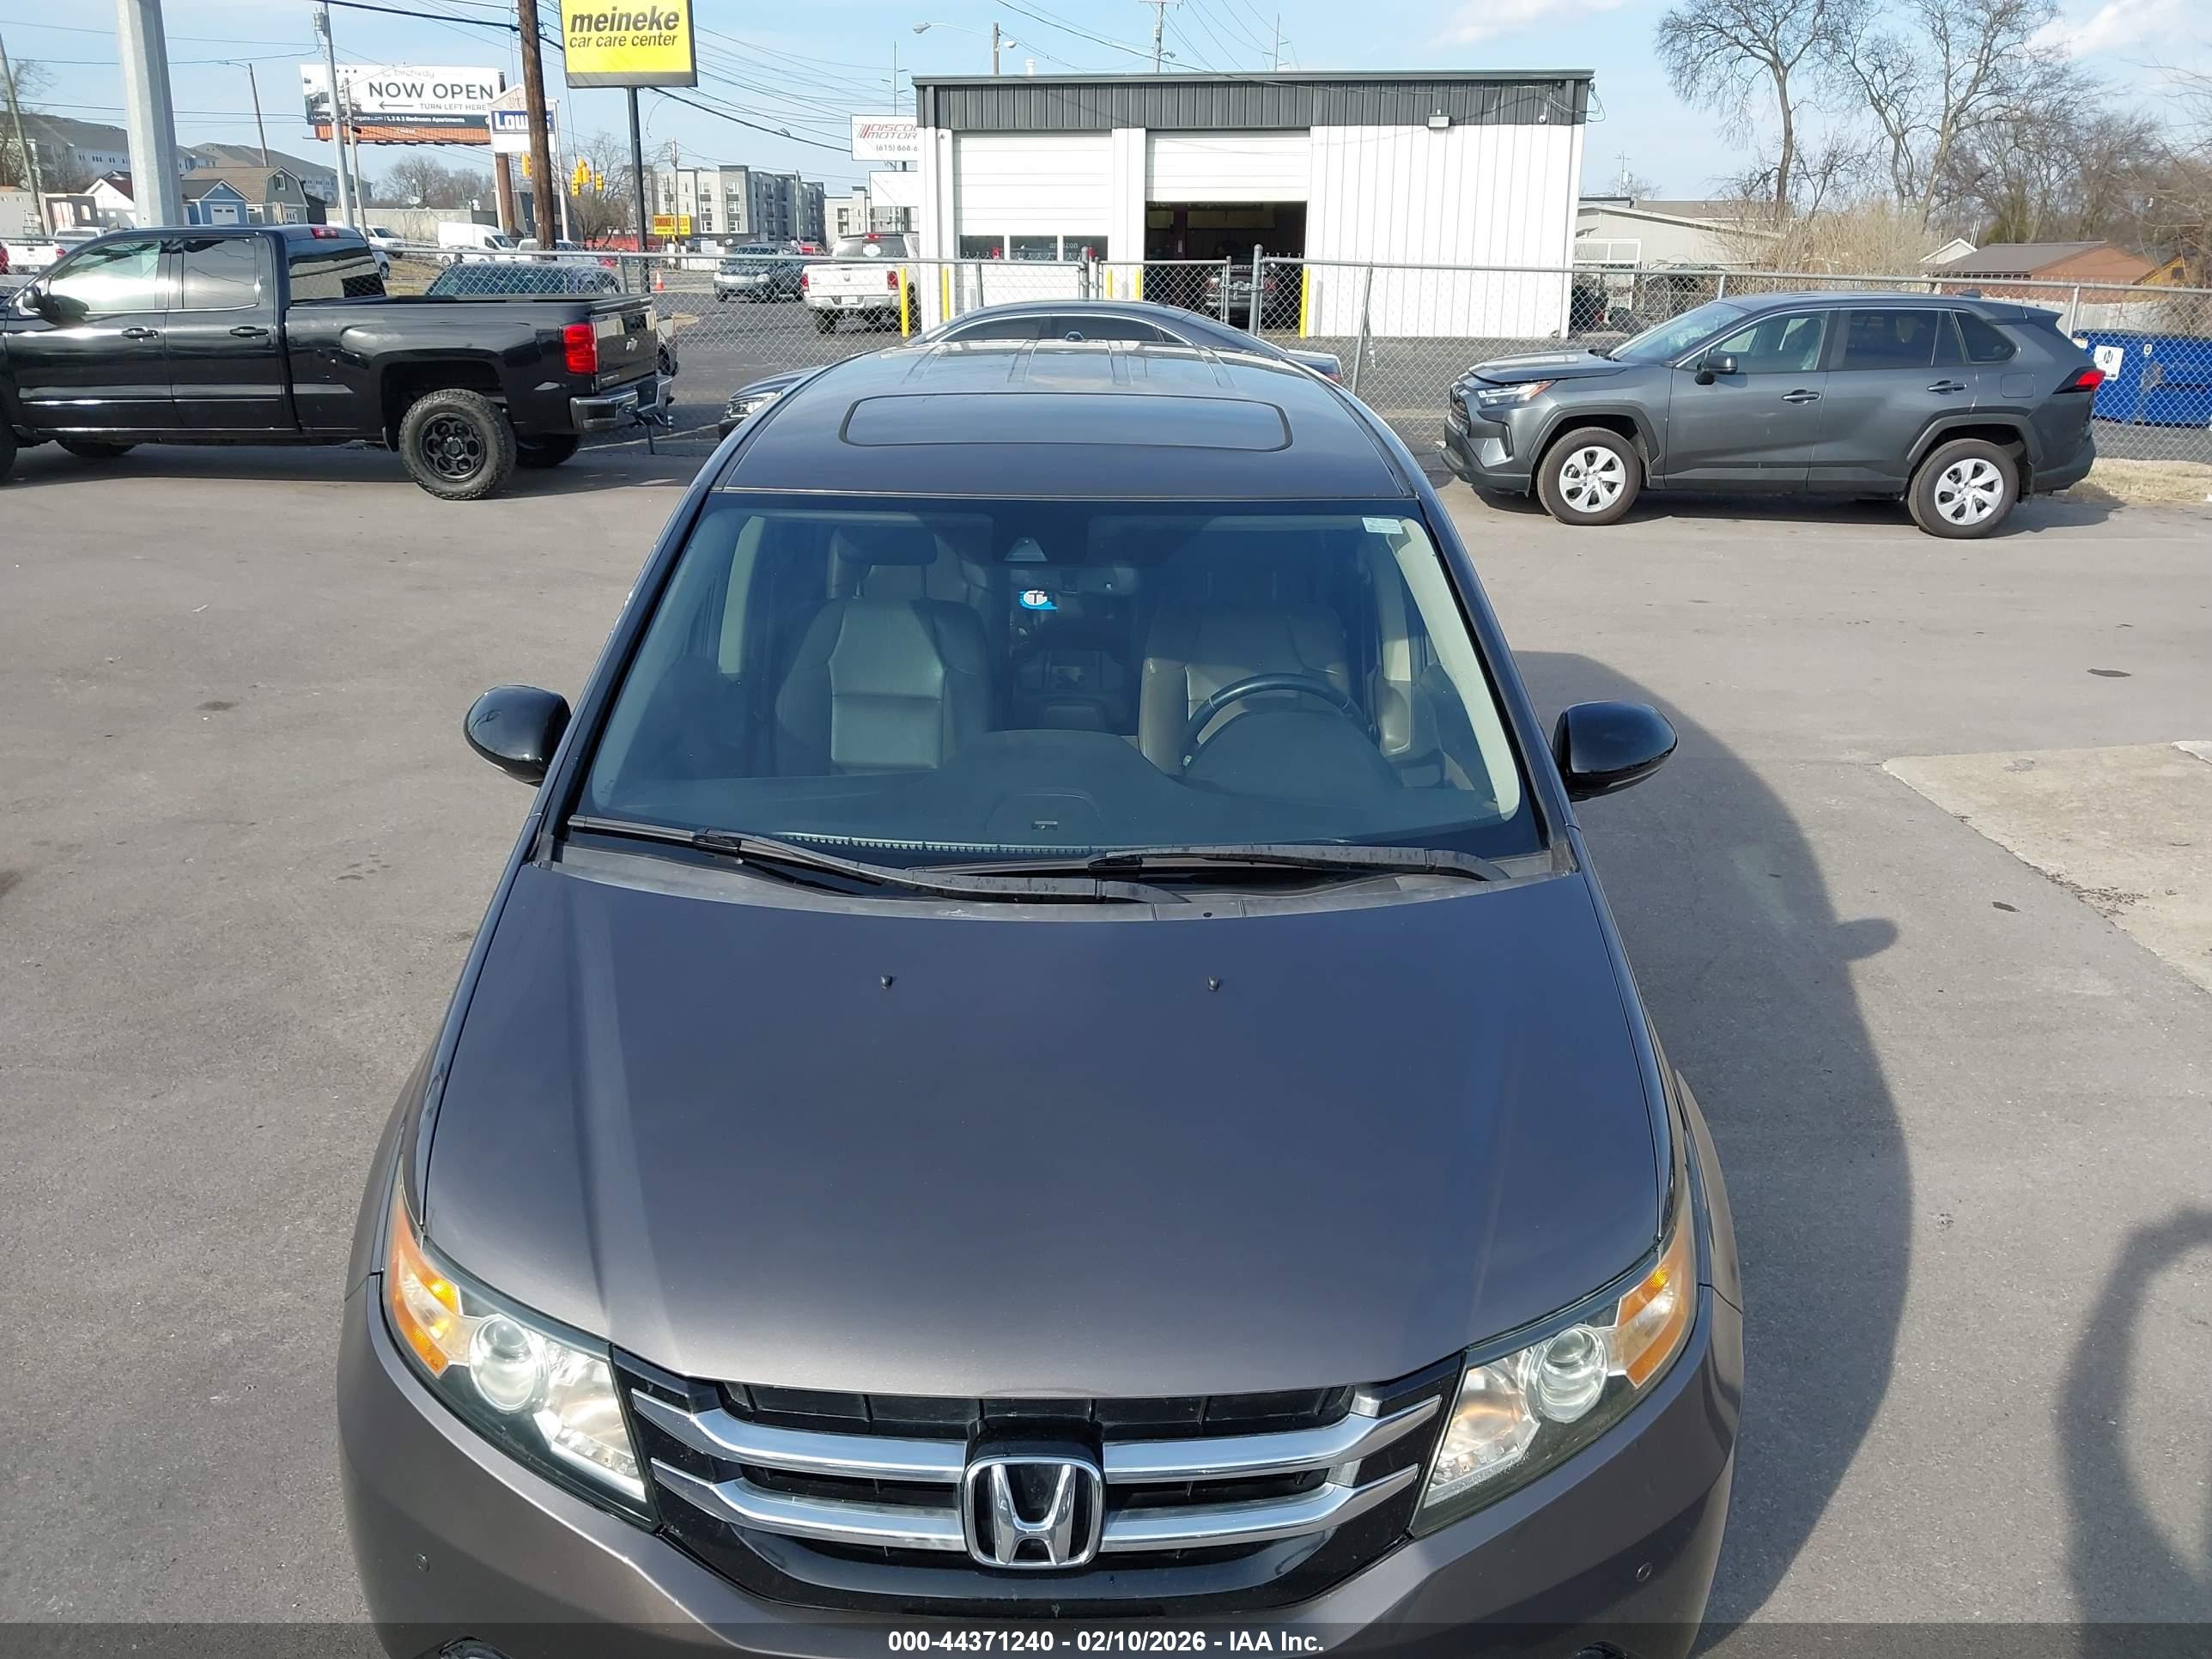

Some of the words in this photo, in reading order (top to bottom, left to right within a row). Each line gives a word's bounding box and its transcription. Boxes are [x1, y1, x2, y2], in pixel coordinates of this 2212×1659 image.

[570, 6, 679, 32] meineke
[569, 36, 592, 48] car
[596, 35, 627, 47] care
[631, 32, 678, 46] center
[368, 82, 424, 98] NOW
[432, 83, 494, 100] OPEN
